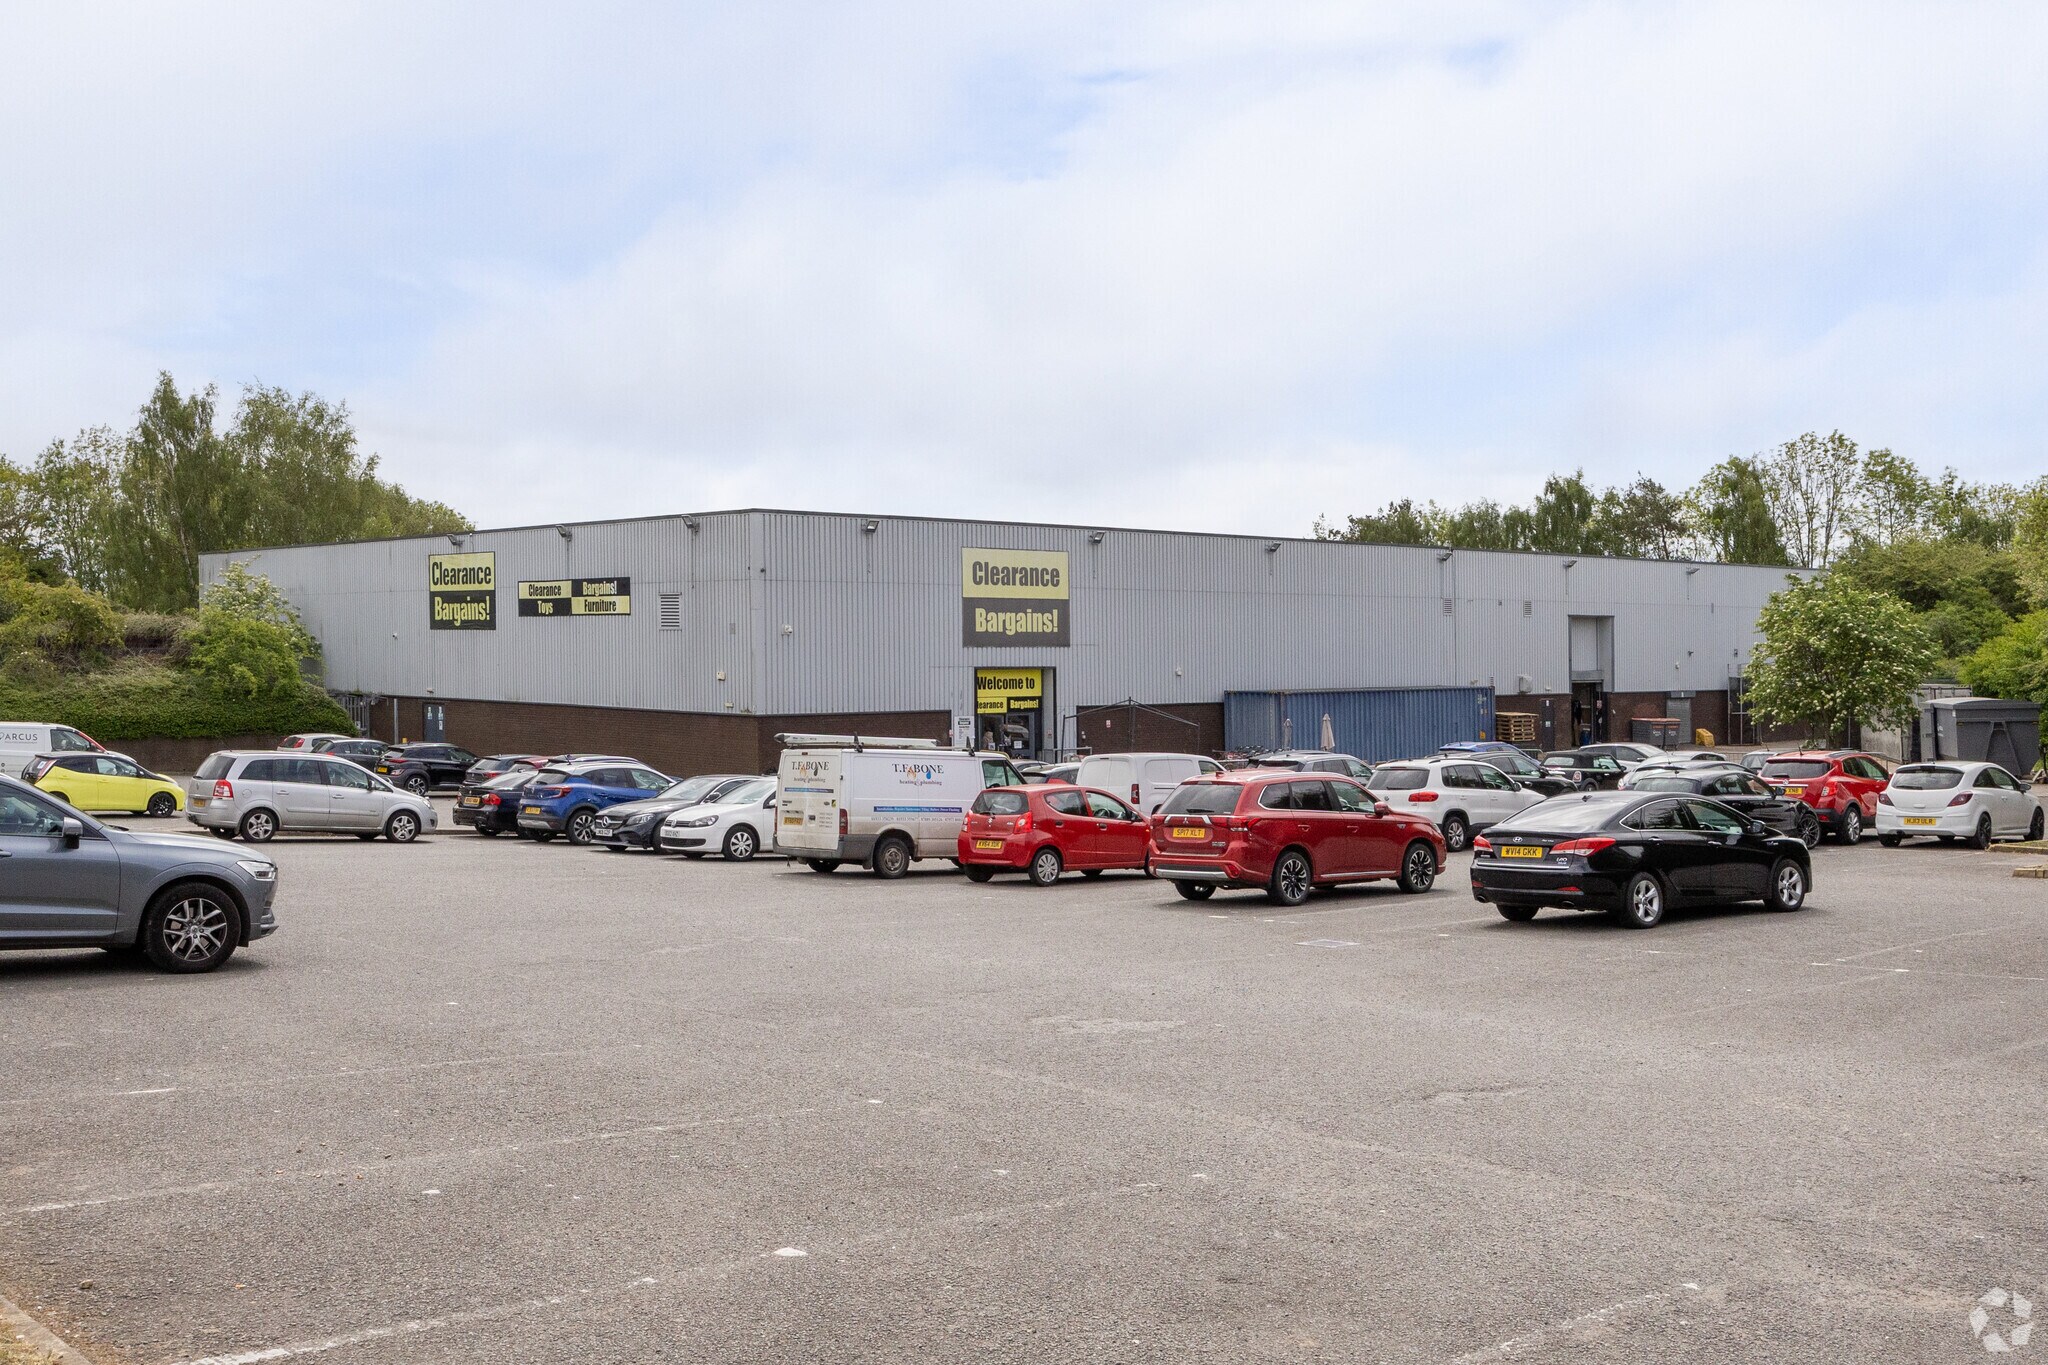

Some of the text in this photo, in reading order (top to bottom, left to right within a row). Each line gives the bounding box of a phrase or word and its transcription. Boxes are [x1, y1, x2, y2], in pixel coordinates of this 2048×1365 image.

[431, 561, 492, 586] Clearance
[972, 561, 1060, 587] Clearance
[528, 583, 562, 597] Clearance
[582, 580, 618, 597] Bargains!
[434, 596, 490, 627] Bargains!
[537, 600, 554, 614] Toys
[584, 599, 617, 613] Furniture
[975, 607, 1058, 636] Bargains!
[977, 676, 1035, 690] Welcome to
[977, 700, 1004, 709] learance
[1009, 699, 1039, 710] Bargains!
[4, 733, 38, 741] ARCUS
[1522, 848, 1538, 857] GKK
